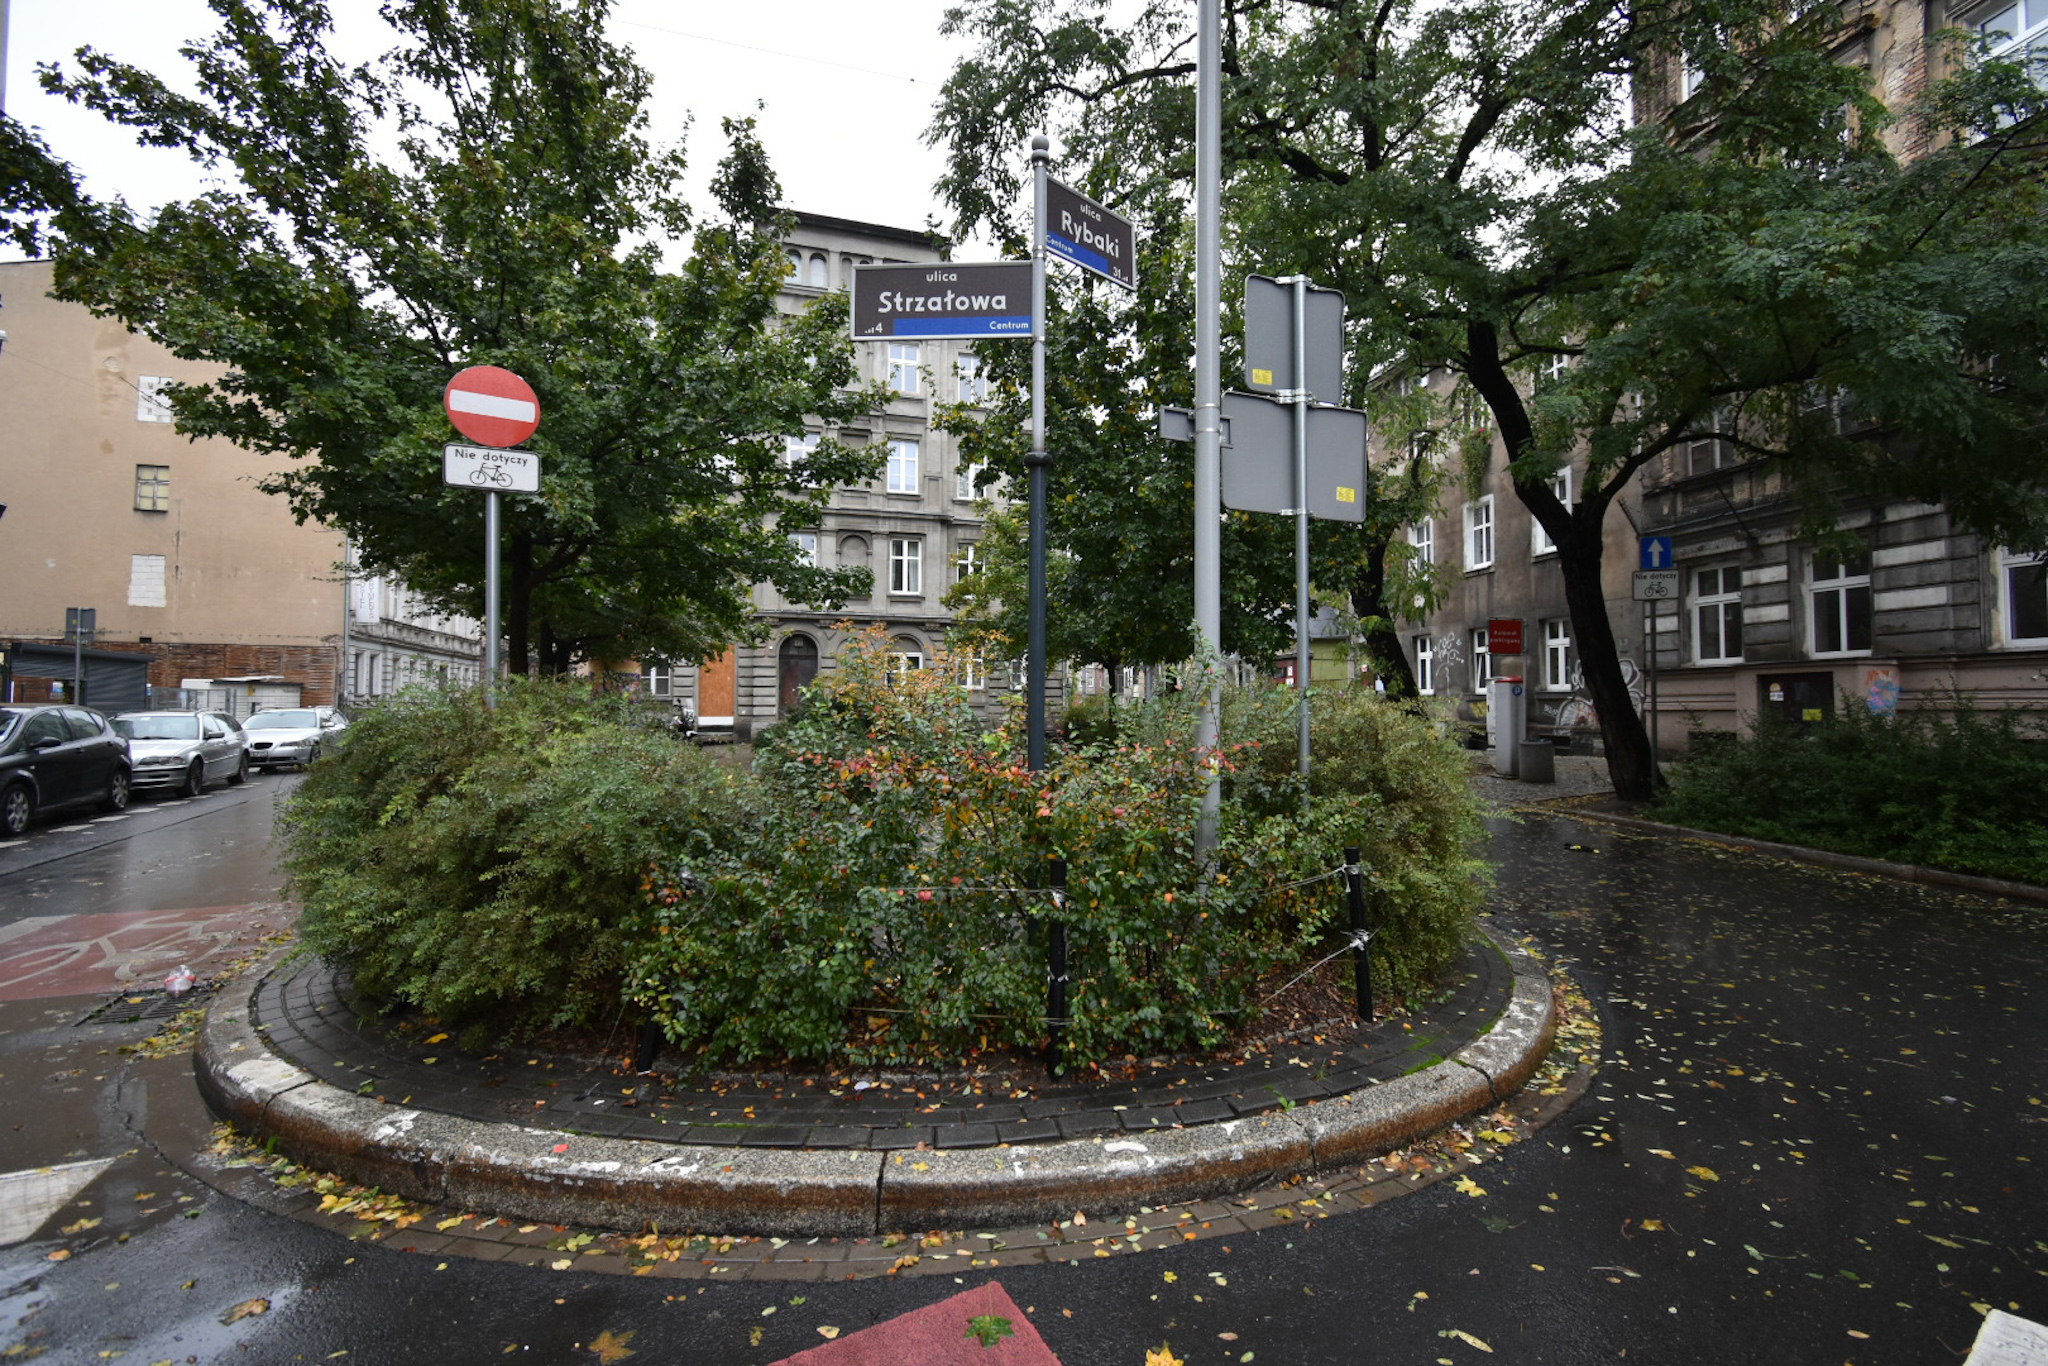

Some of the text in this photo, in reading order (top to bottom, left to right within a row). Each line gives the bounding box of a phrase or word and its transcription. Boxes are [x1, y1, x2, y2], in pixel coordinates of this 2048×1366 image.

[1079, 203, 1101, 223] ulica
[1045, 234, 1075, 254] Centrum
[1061, 211, 1119, 258] Rybaki
[925, 270, 958, 282] ulica
[877, 289, 1007, 314] Strzałowa
[989, 319, 1029, 331] Centrum
[455, 448, 528, 467] Nie dotyczy
[1650, 572, 1677, 581] dotyczy
